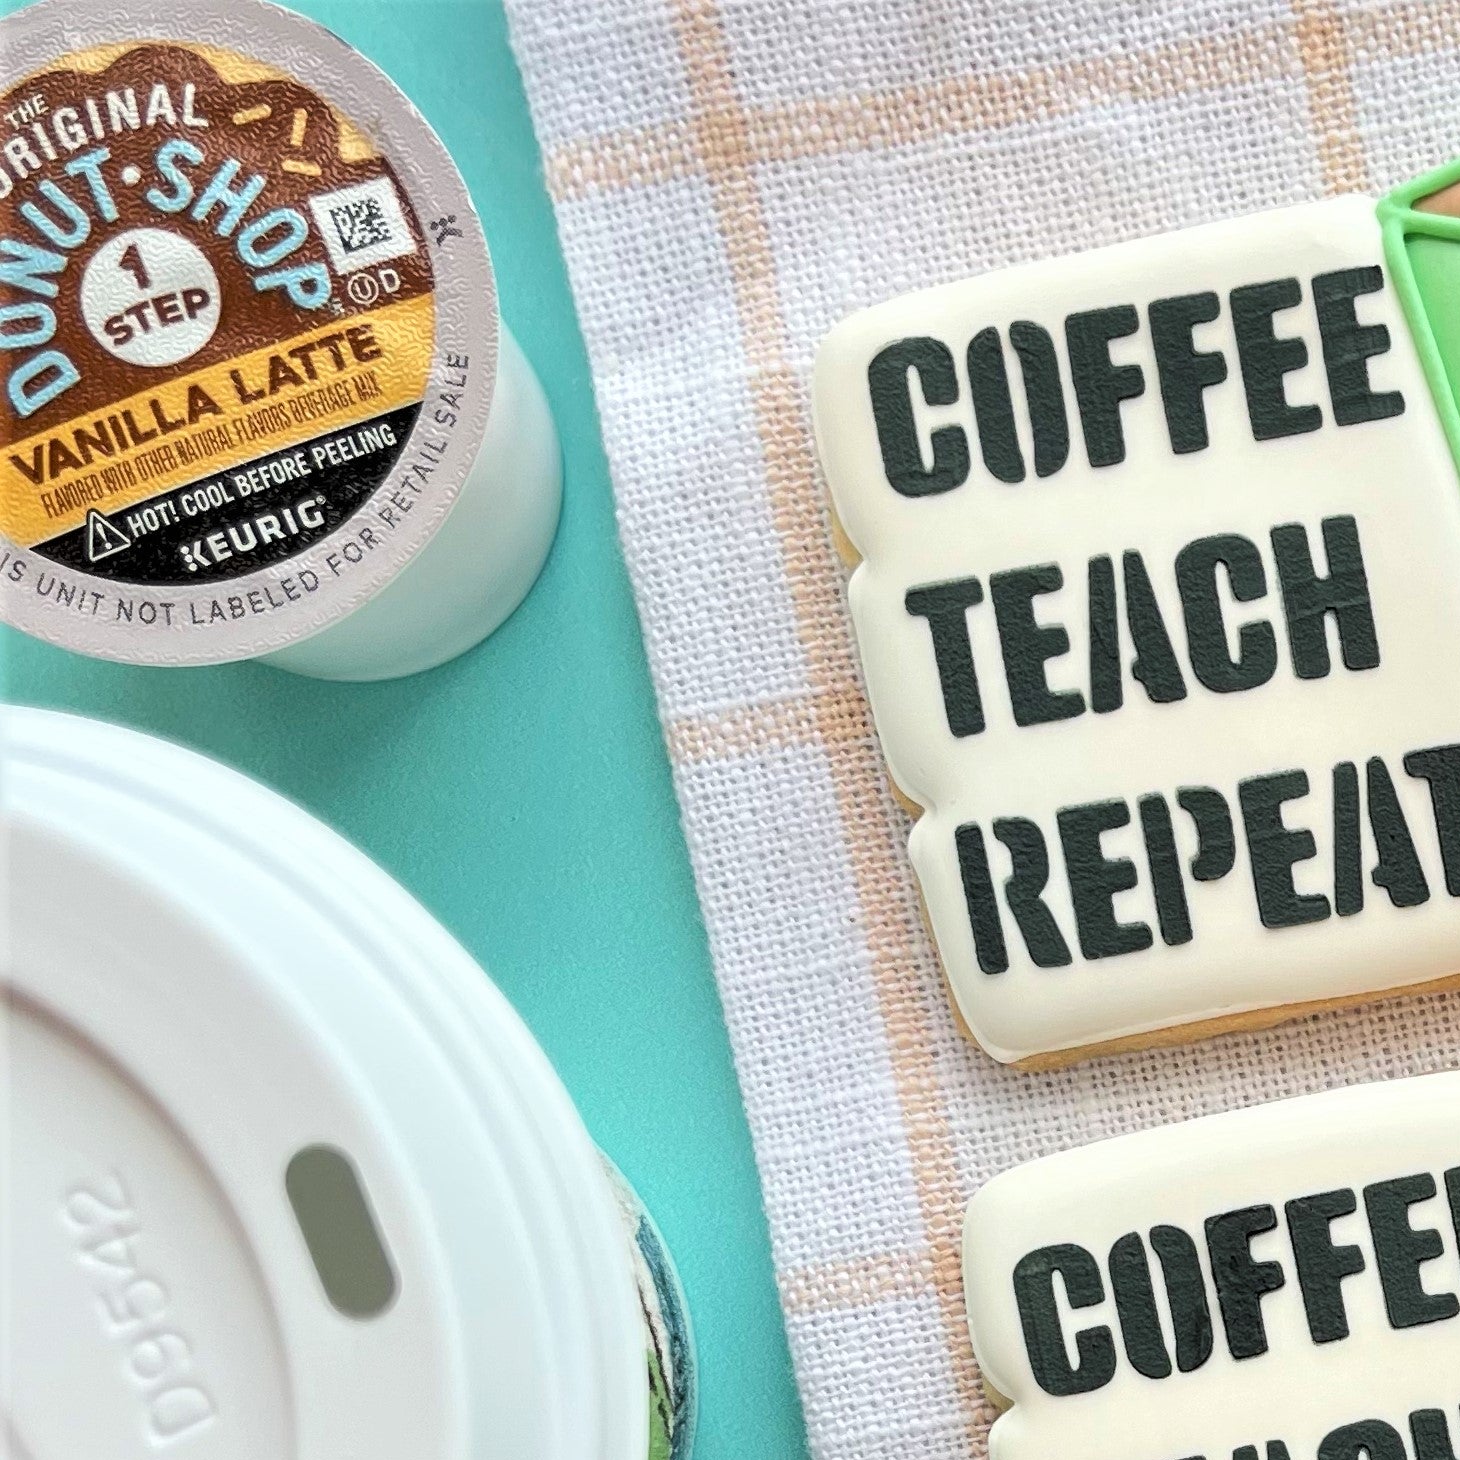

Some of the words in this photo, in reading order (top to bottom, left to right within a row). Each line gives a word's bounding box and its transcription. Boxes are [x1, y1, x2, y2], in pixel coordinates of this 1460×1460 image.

[3, 94, 49, 131] THE
[0, 147, 120, 419] DONUT
[146, 138, 332, 310] SHOP
[103, 287, 211, 347] STEP
[118, 241, 151, 291] 1
[8, 384, 225, 486] VANILLA
[229, 323, 383, 404] LATTE
[40, 476, 104, 519] FLAVORED
[102, 464, 136, 496] WITH
[135, 451, 177, 486] OTHER
[177, 430, 240, 471] NATURAL
[234, 402, 292, 444] FLAVORS
[290, 380, 355, 424] BEVERAGE
[353, 370, 383, 402] MIX
[867, 264, 1406, 498] COFFEE
[36, 572, 105, 616] UNIT
[116, 598, 176, 626] NOT
[190, 569, 321, 626] LABELED
[325, 527, 381, 577] FOR
[378, 438, 447, 529] RETAIL
[434, 354, 470, 428] SALE
[127, 501, 180, 538] HOT!
[183, 484, 235, 518] COOL
[233, 452, 313, 499] BEFORE
[312, 423, 398, 470] PEELING
[179, 499, 326, 572] KEURIG
[904, 515, 1380, 738] TEACH
[56, 1168, 218, 1451] D9542
